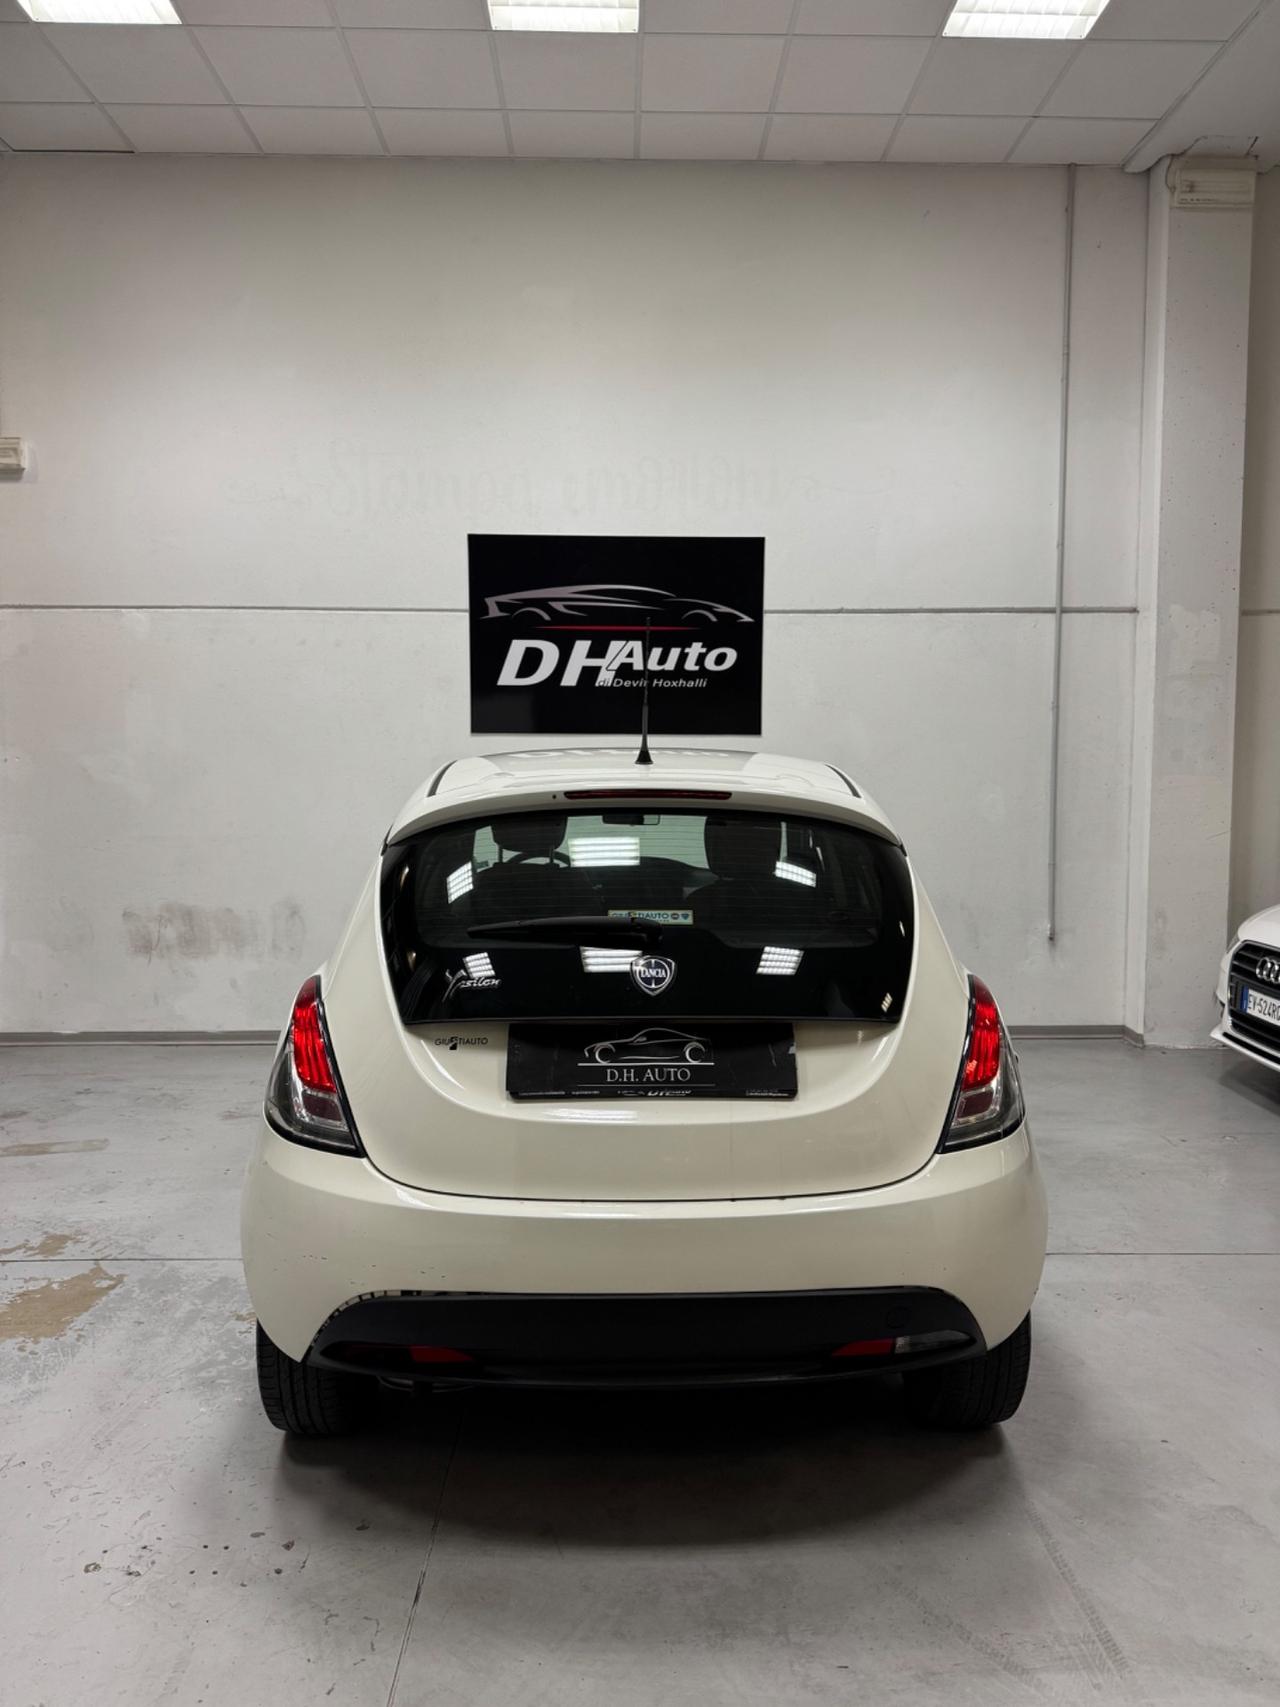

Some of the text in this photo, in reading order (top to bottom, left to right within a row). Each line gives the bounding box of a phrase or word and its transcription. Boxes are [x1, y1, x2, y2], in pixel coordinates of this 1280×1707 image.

[652, 678, 708, 688] Hoxhalli
[640, 968, 667, 978] LANCIA
[606, 1067, 692, 1083] D.H. AUTO
